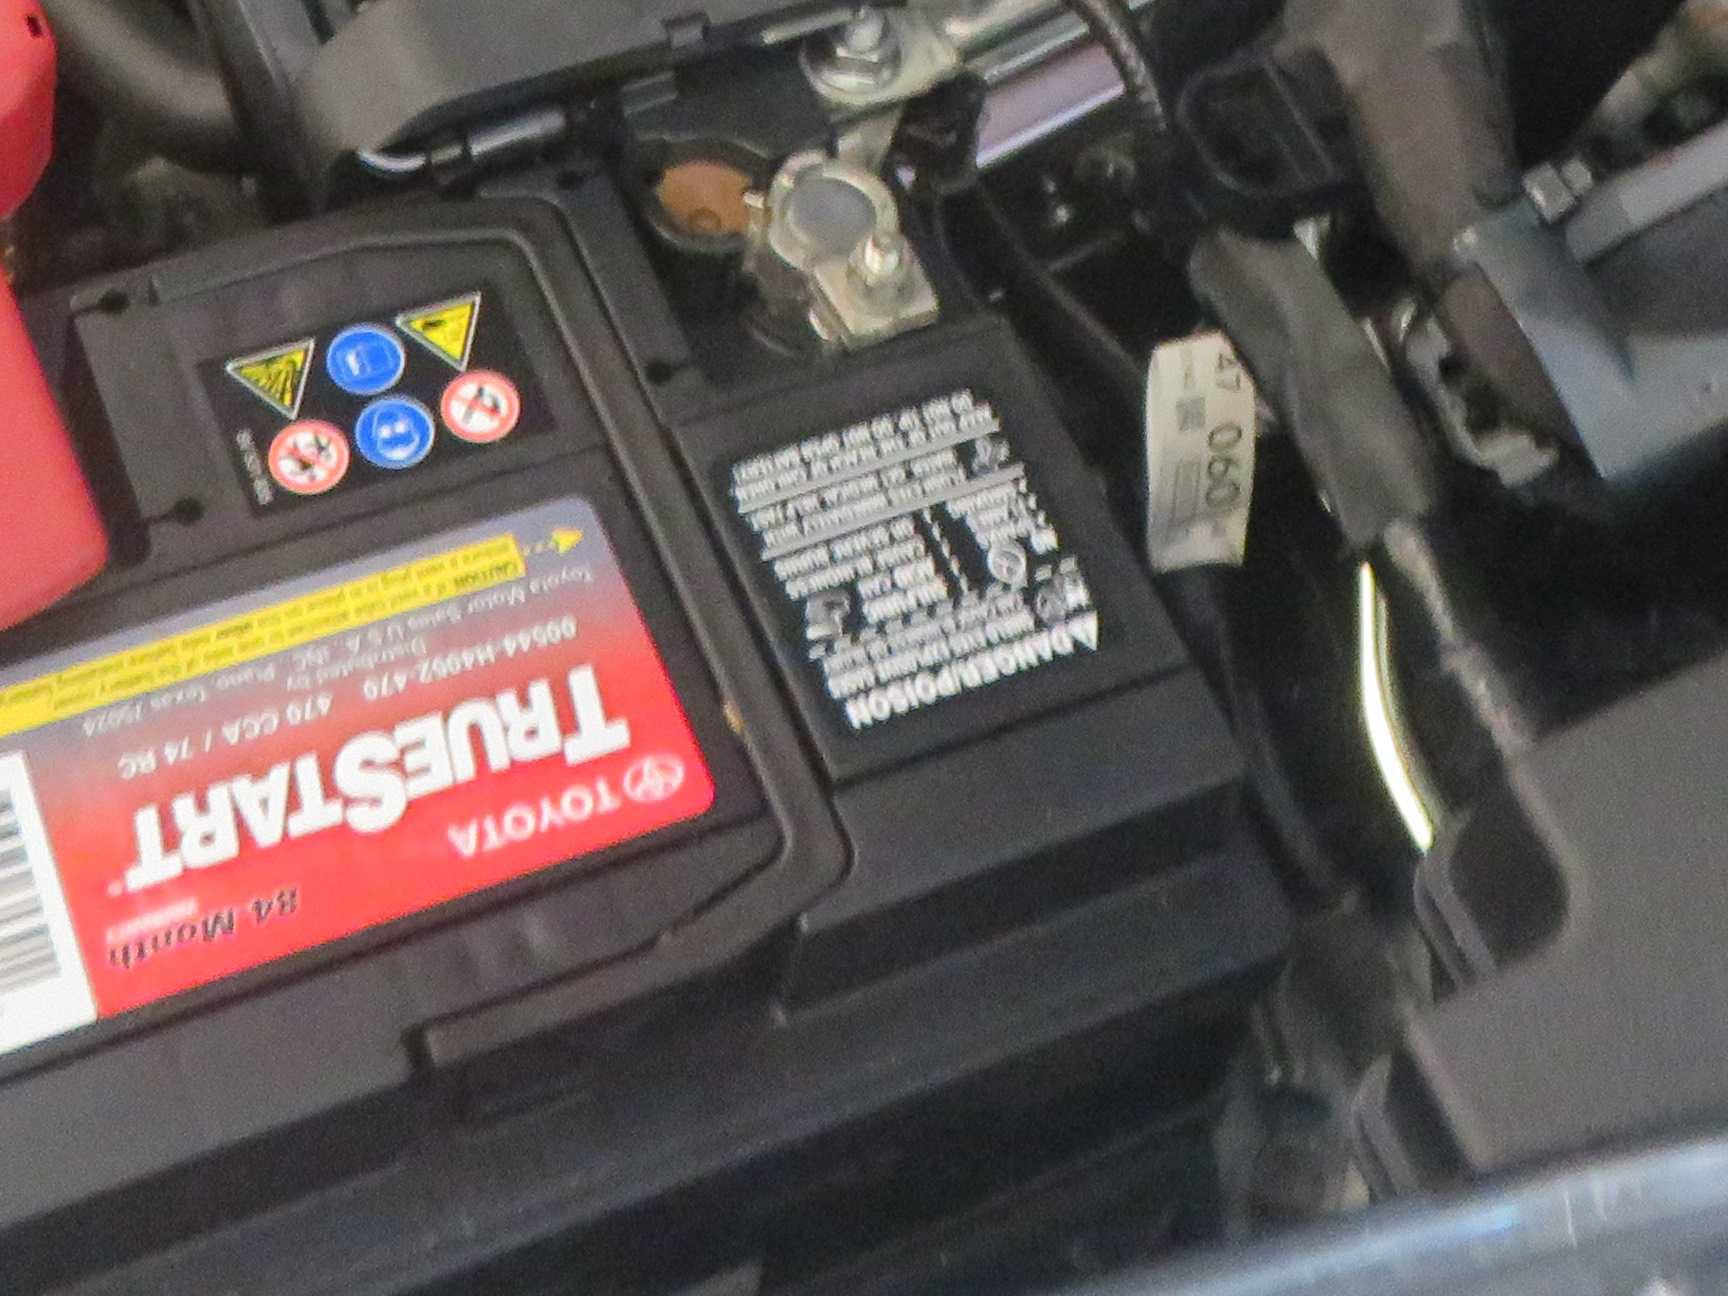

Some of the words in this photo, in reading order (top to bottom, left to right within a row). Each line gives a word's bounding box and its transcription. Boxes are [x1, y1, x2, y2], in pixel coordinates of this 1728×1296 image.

[464, 581, 527, 615] Motor
[526, 562, 594, 596] Toyota
[842, 621, 1075, 729] DANGER/POISON
[446, 778, 619, 857] TOYOTA
[106, 908, 237, 969] Month
